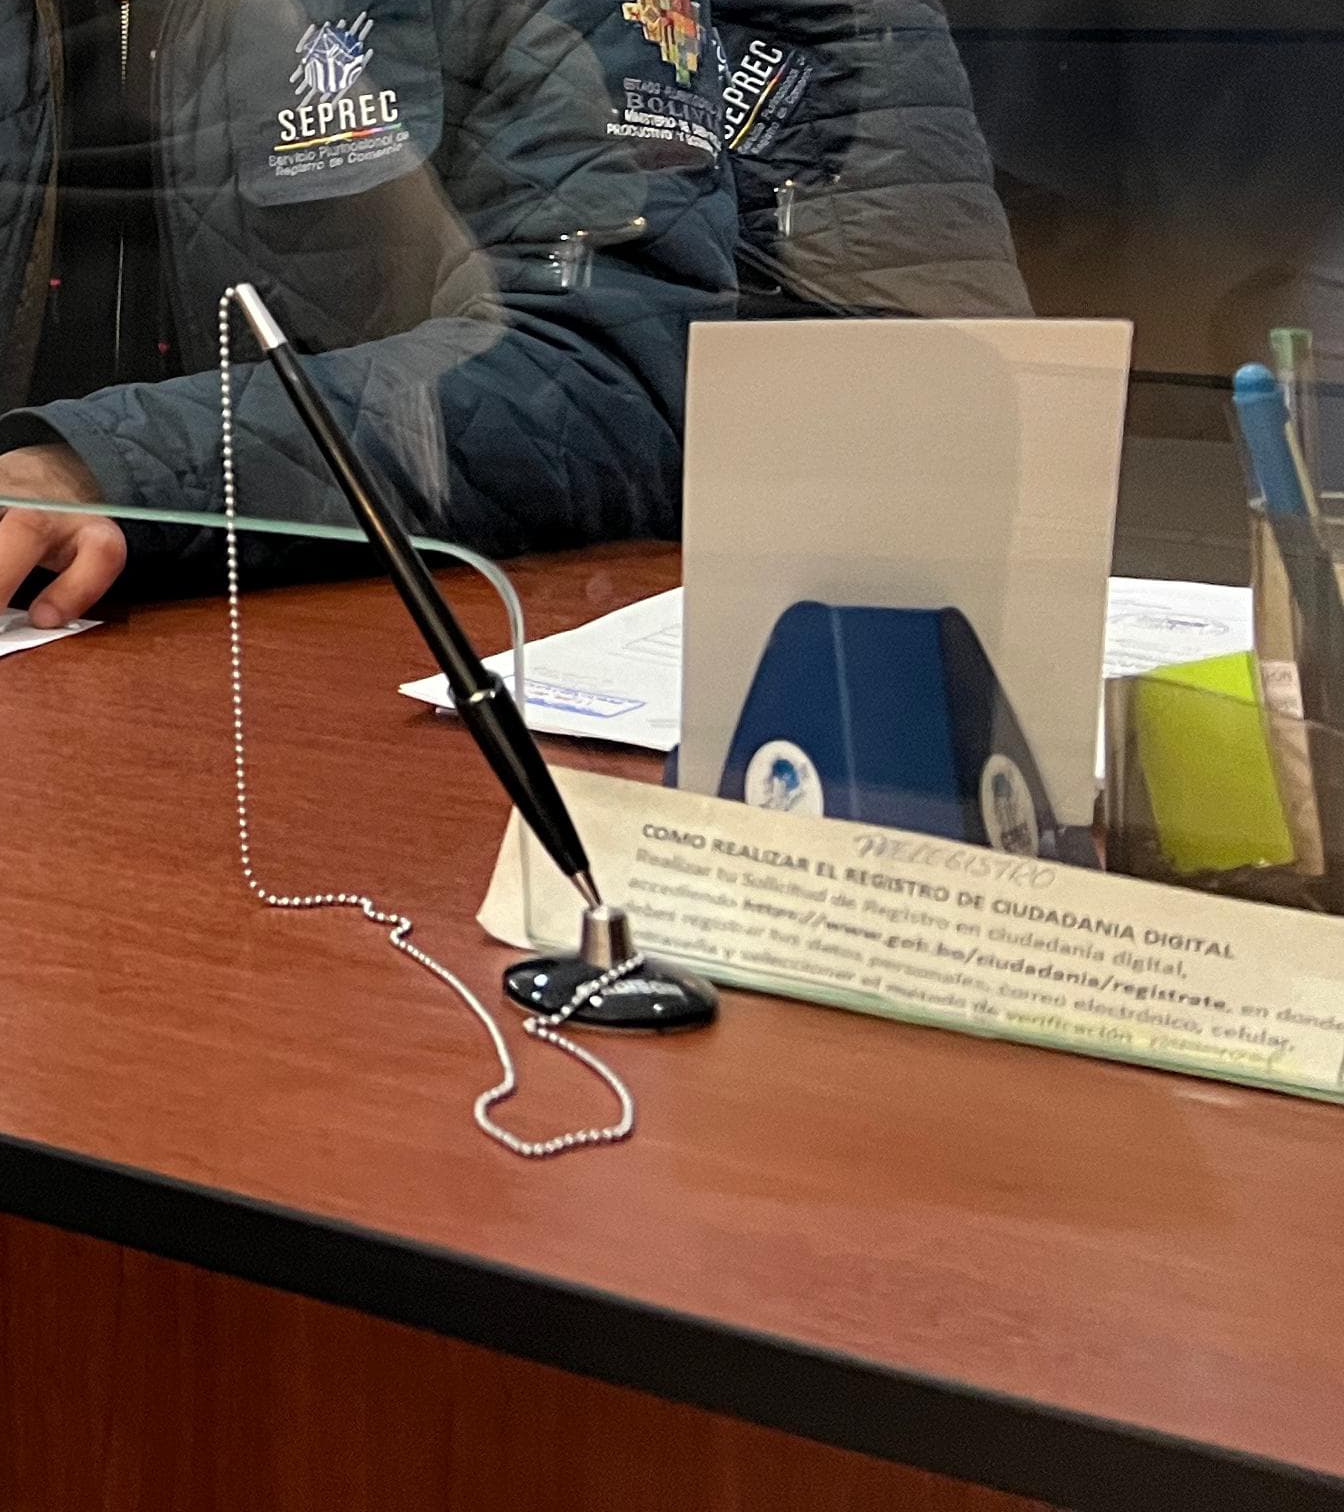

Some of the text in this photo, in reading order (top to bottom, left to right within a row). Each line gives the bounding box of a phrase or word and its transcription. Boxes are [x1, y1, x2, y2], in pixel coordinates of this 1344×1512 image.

[278, 90, 398, 142] SEPREC
[722, 40, 783, 140] SEPREC
[642, 823, 1235, 959] COMO REALIZAR EL REGISTRO DE CIUDADANIA DIGITAL
[863, 897, 949, 930] Registro
[957, 921, 981, 938] en
[1113, 950, 1187, 978] digital,
